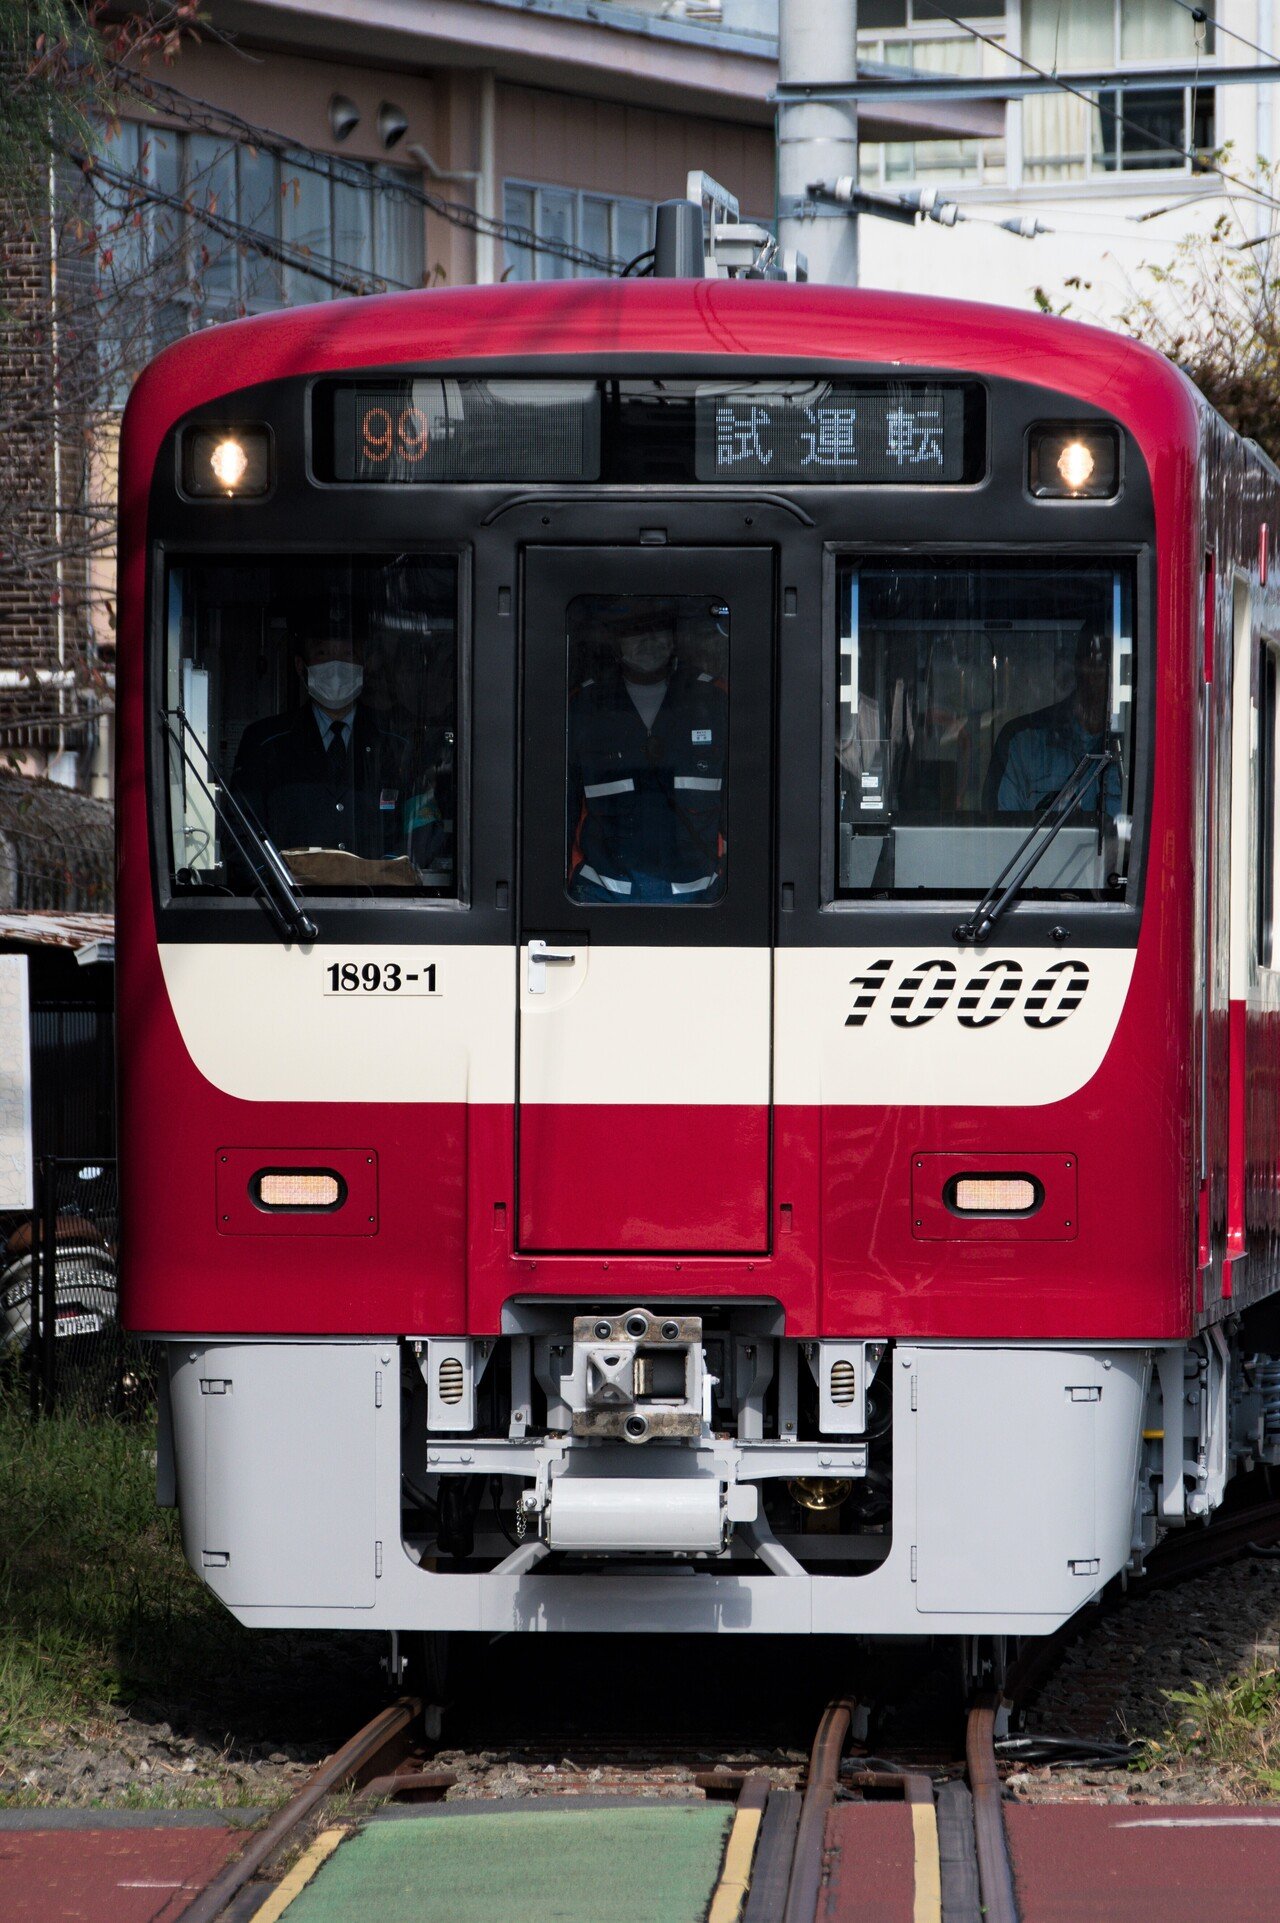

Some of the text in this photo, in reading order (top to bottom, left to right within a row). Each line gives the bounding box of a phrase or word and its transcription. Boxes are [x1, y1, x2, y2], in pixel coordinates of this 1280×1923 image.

[363, 408, 428, 462] 99
[716, 406, 943, 465] 試運転
[327, 962, 436, 992] 1893-1
[844, 959, 1090, 1029] 1000
